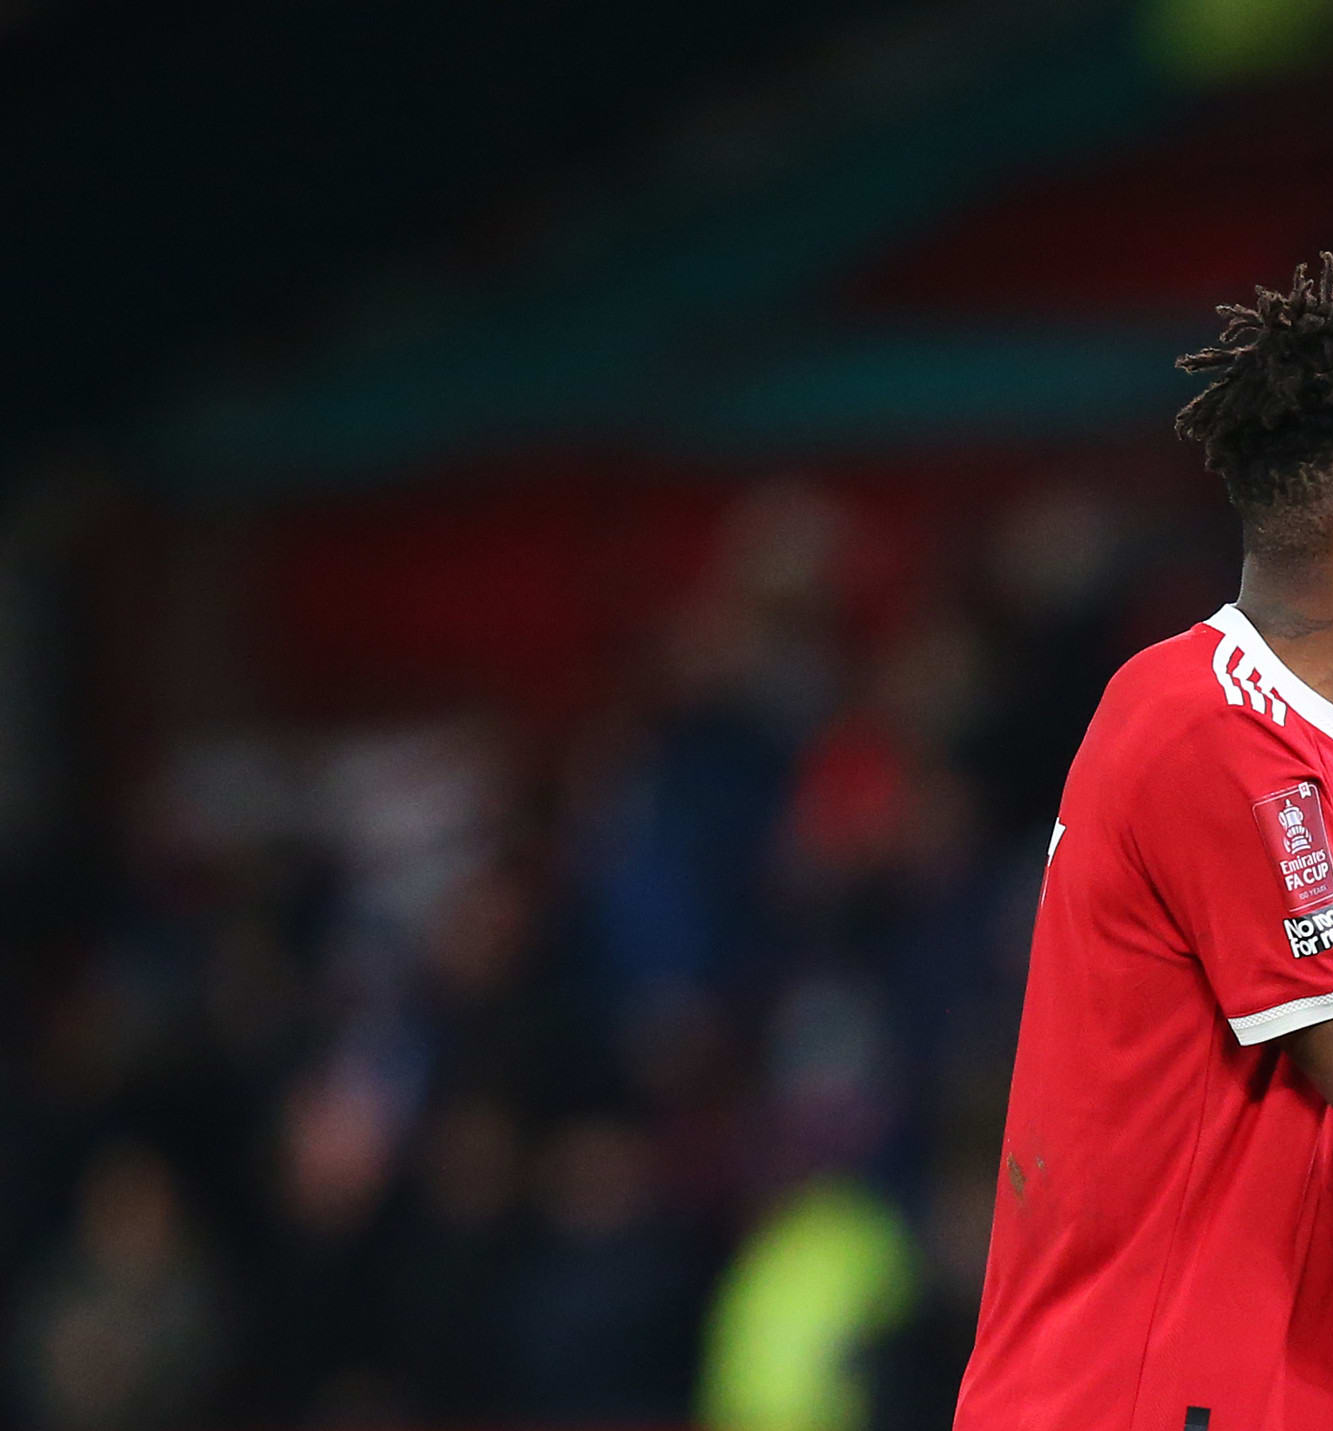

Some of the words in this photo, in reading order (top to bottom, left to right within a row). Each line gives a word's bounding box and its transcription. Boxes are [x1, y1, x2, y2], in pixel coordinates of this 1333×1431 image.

[1280, 849, 1326, 875] Emirates
[1285, 873, 1304, 891] FA
[1304, 862, 1329, 884] CUP
[1283, 918, 1315, 939] No
[1289, 935, 1319, 958] for
